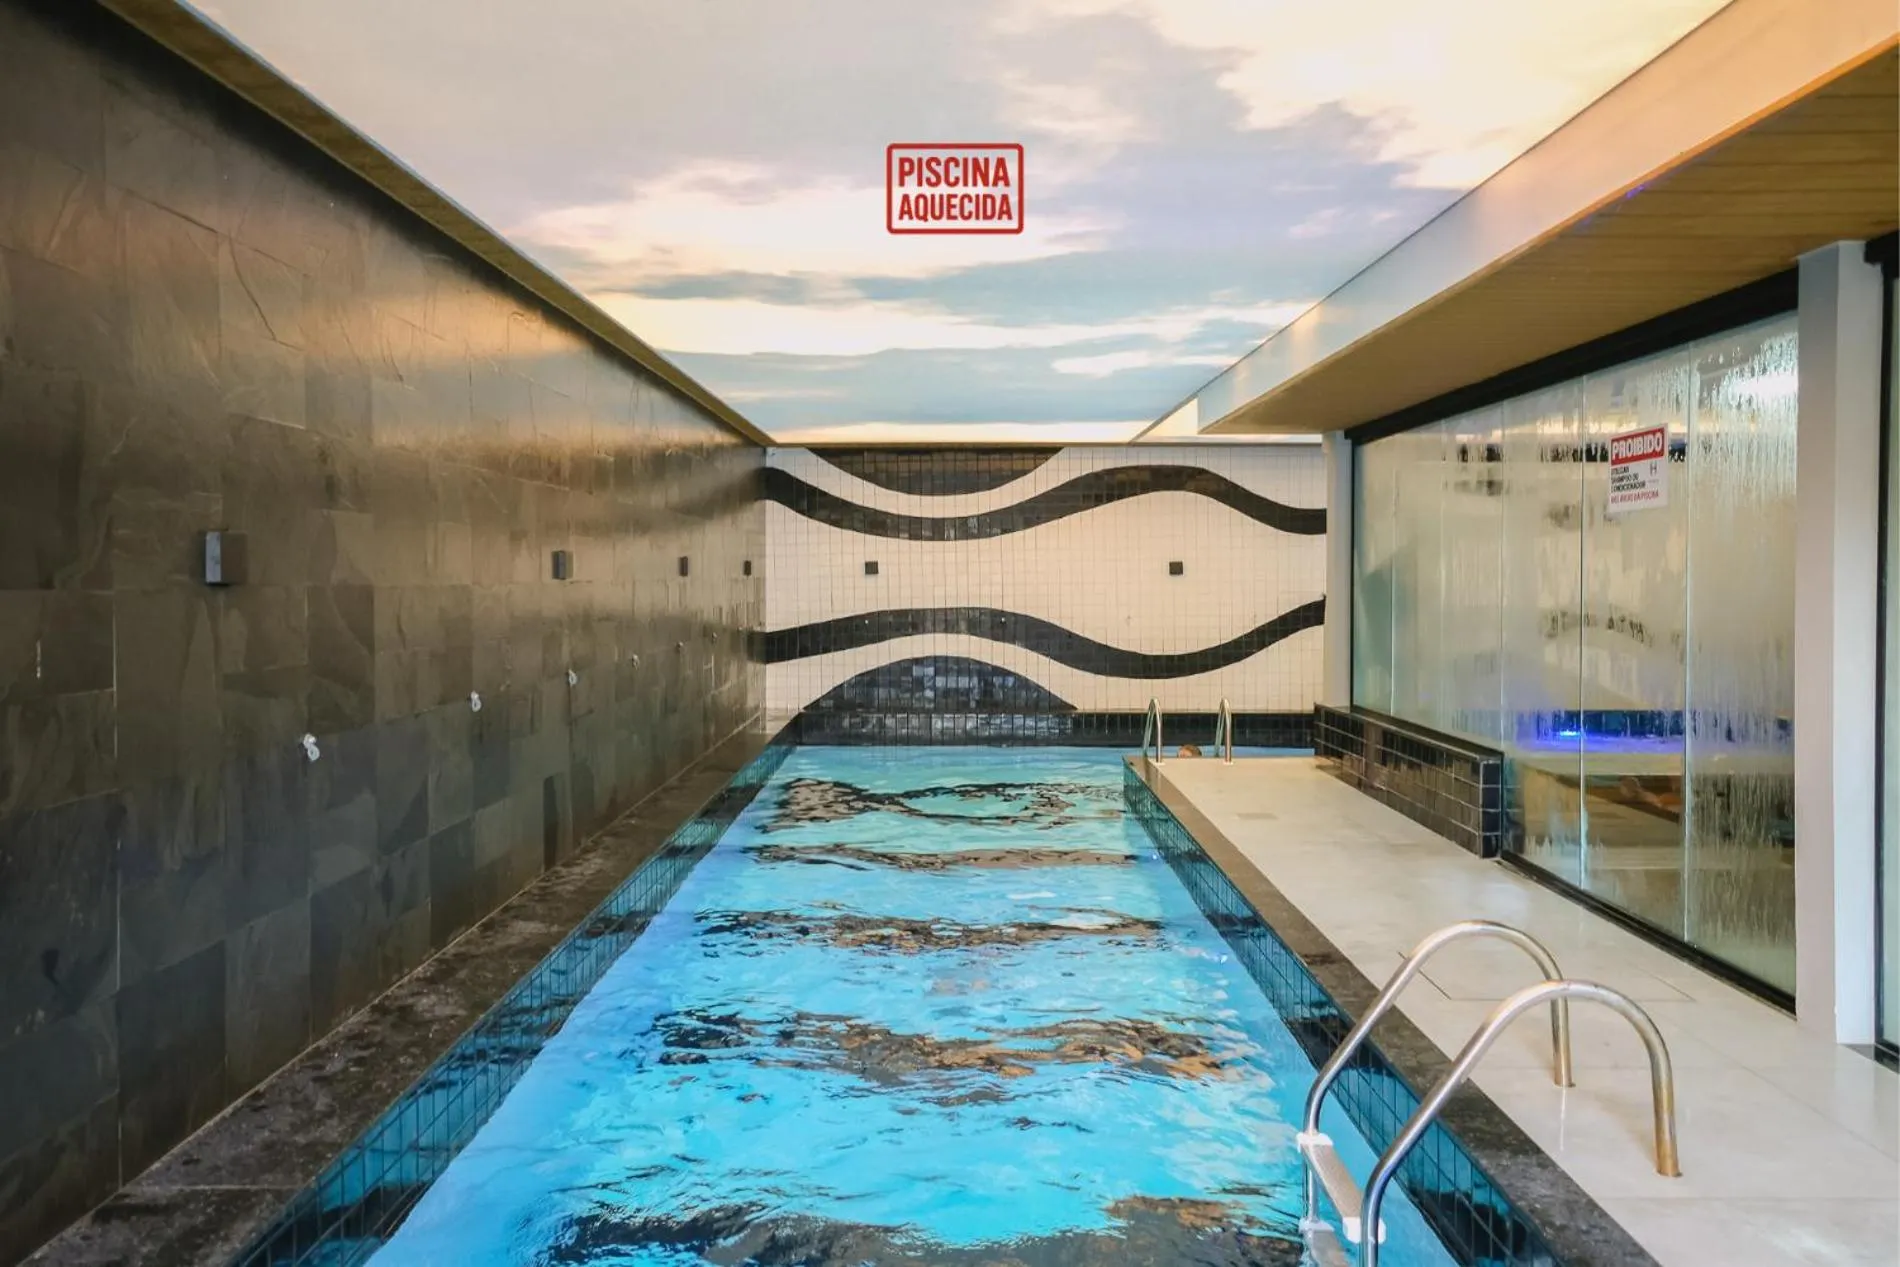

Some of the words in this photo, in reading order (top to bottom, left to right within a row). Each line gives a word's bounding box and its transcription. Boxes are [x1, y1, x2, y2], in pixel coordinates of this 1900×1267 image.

[898, 156, 1011, 188] PISCINA
[898, 193, 1013, 222] AQUECIDA
[1612, 432, 1662, 460] PROIBIDO
